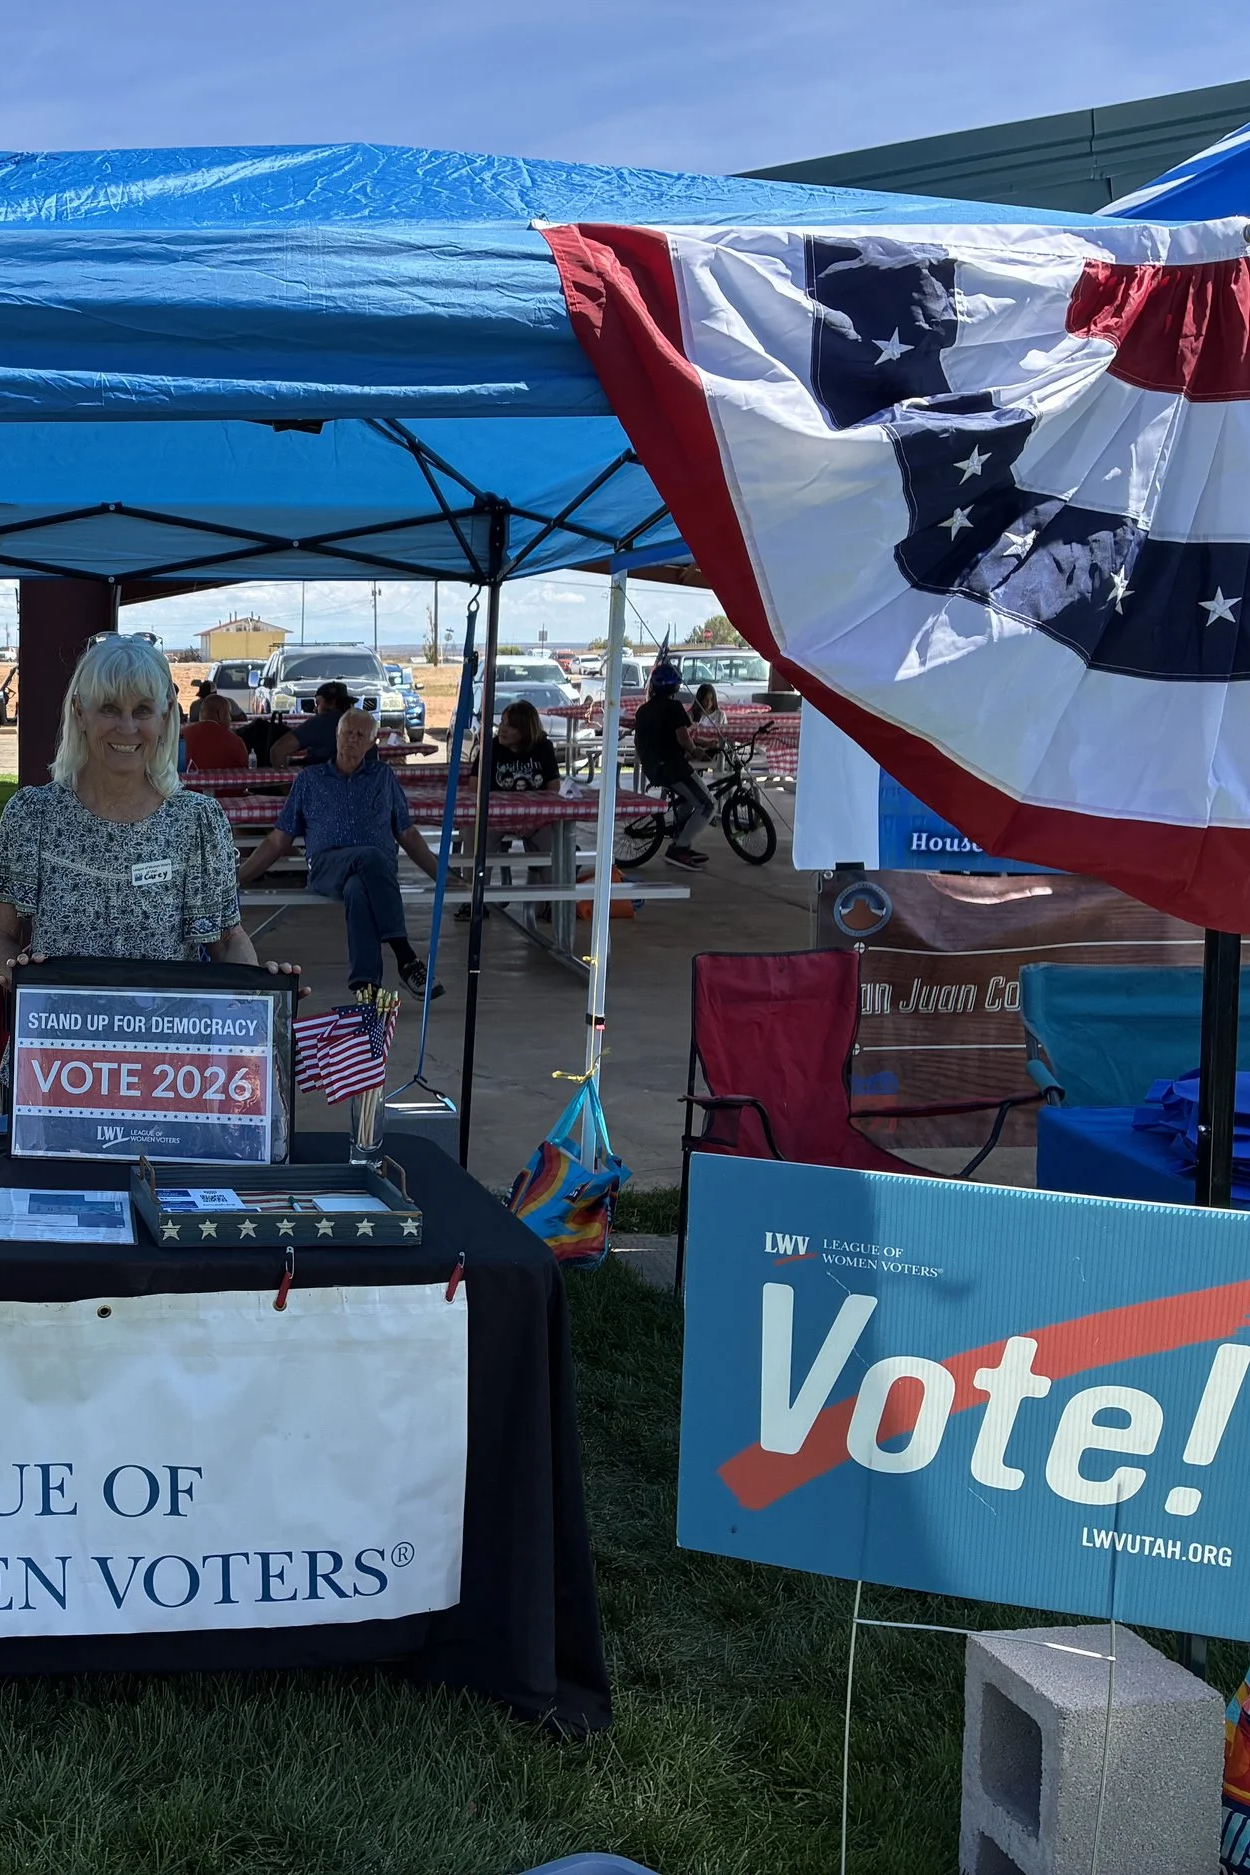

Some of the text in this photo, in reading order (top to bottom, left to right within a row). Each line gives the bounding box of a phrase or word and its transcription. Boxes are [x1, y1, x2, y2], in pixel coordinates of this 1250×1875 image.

[861, 976, 1021, 1014] an Juan Co
[28, 1012, 259, 1038] STAND UP FOR DEMOCRACY
[31, 1059, 254, 1102] VOTE 2026
[97, 1126, 124, 1140] LWV
[764, 1231, 810, 1256] LWV
[823, 1238, 904, 1258] LEAGUE OF
[822, 1253, 878, 1270] WOMEN
[760, 1282, 1250, 1517] Vote!
[102, 1464, 204, 1519] OF
[1082, 1526, 1233, 1567] LWVUTAH.ORG
